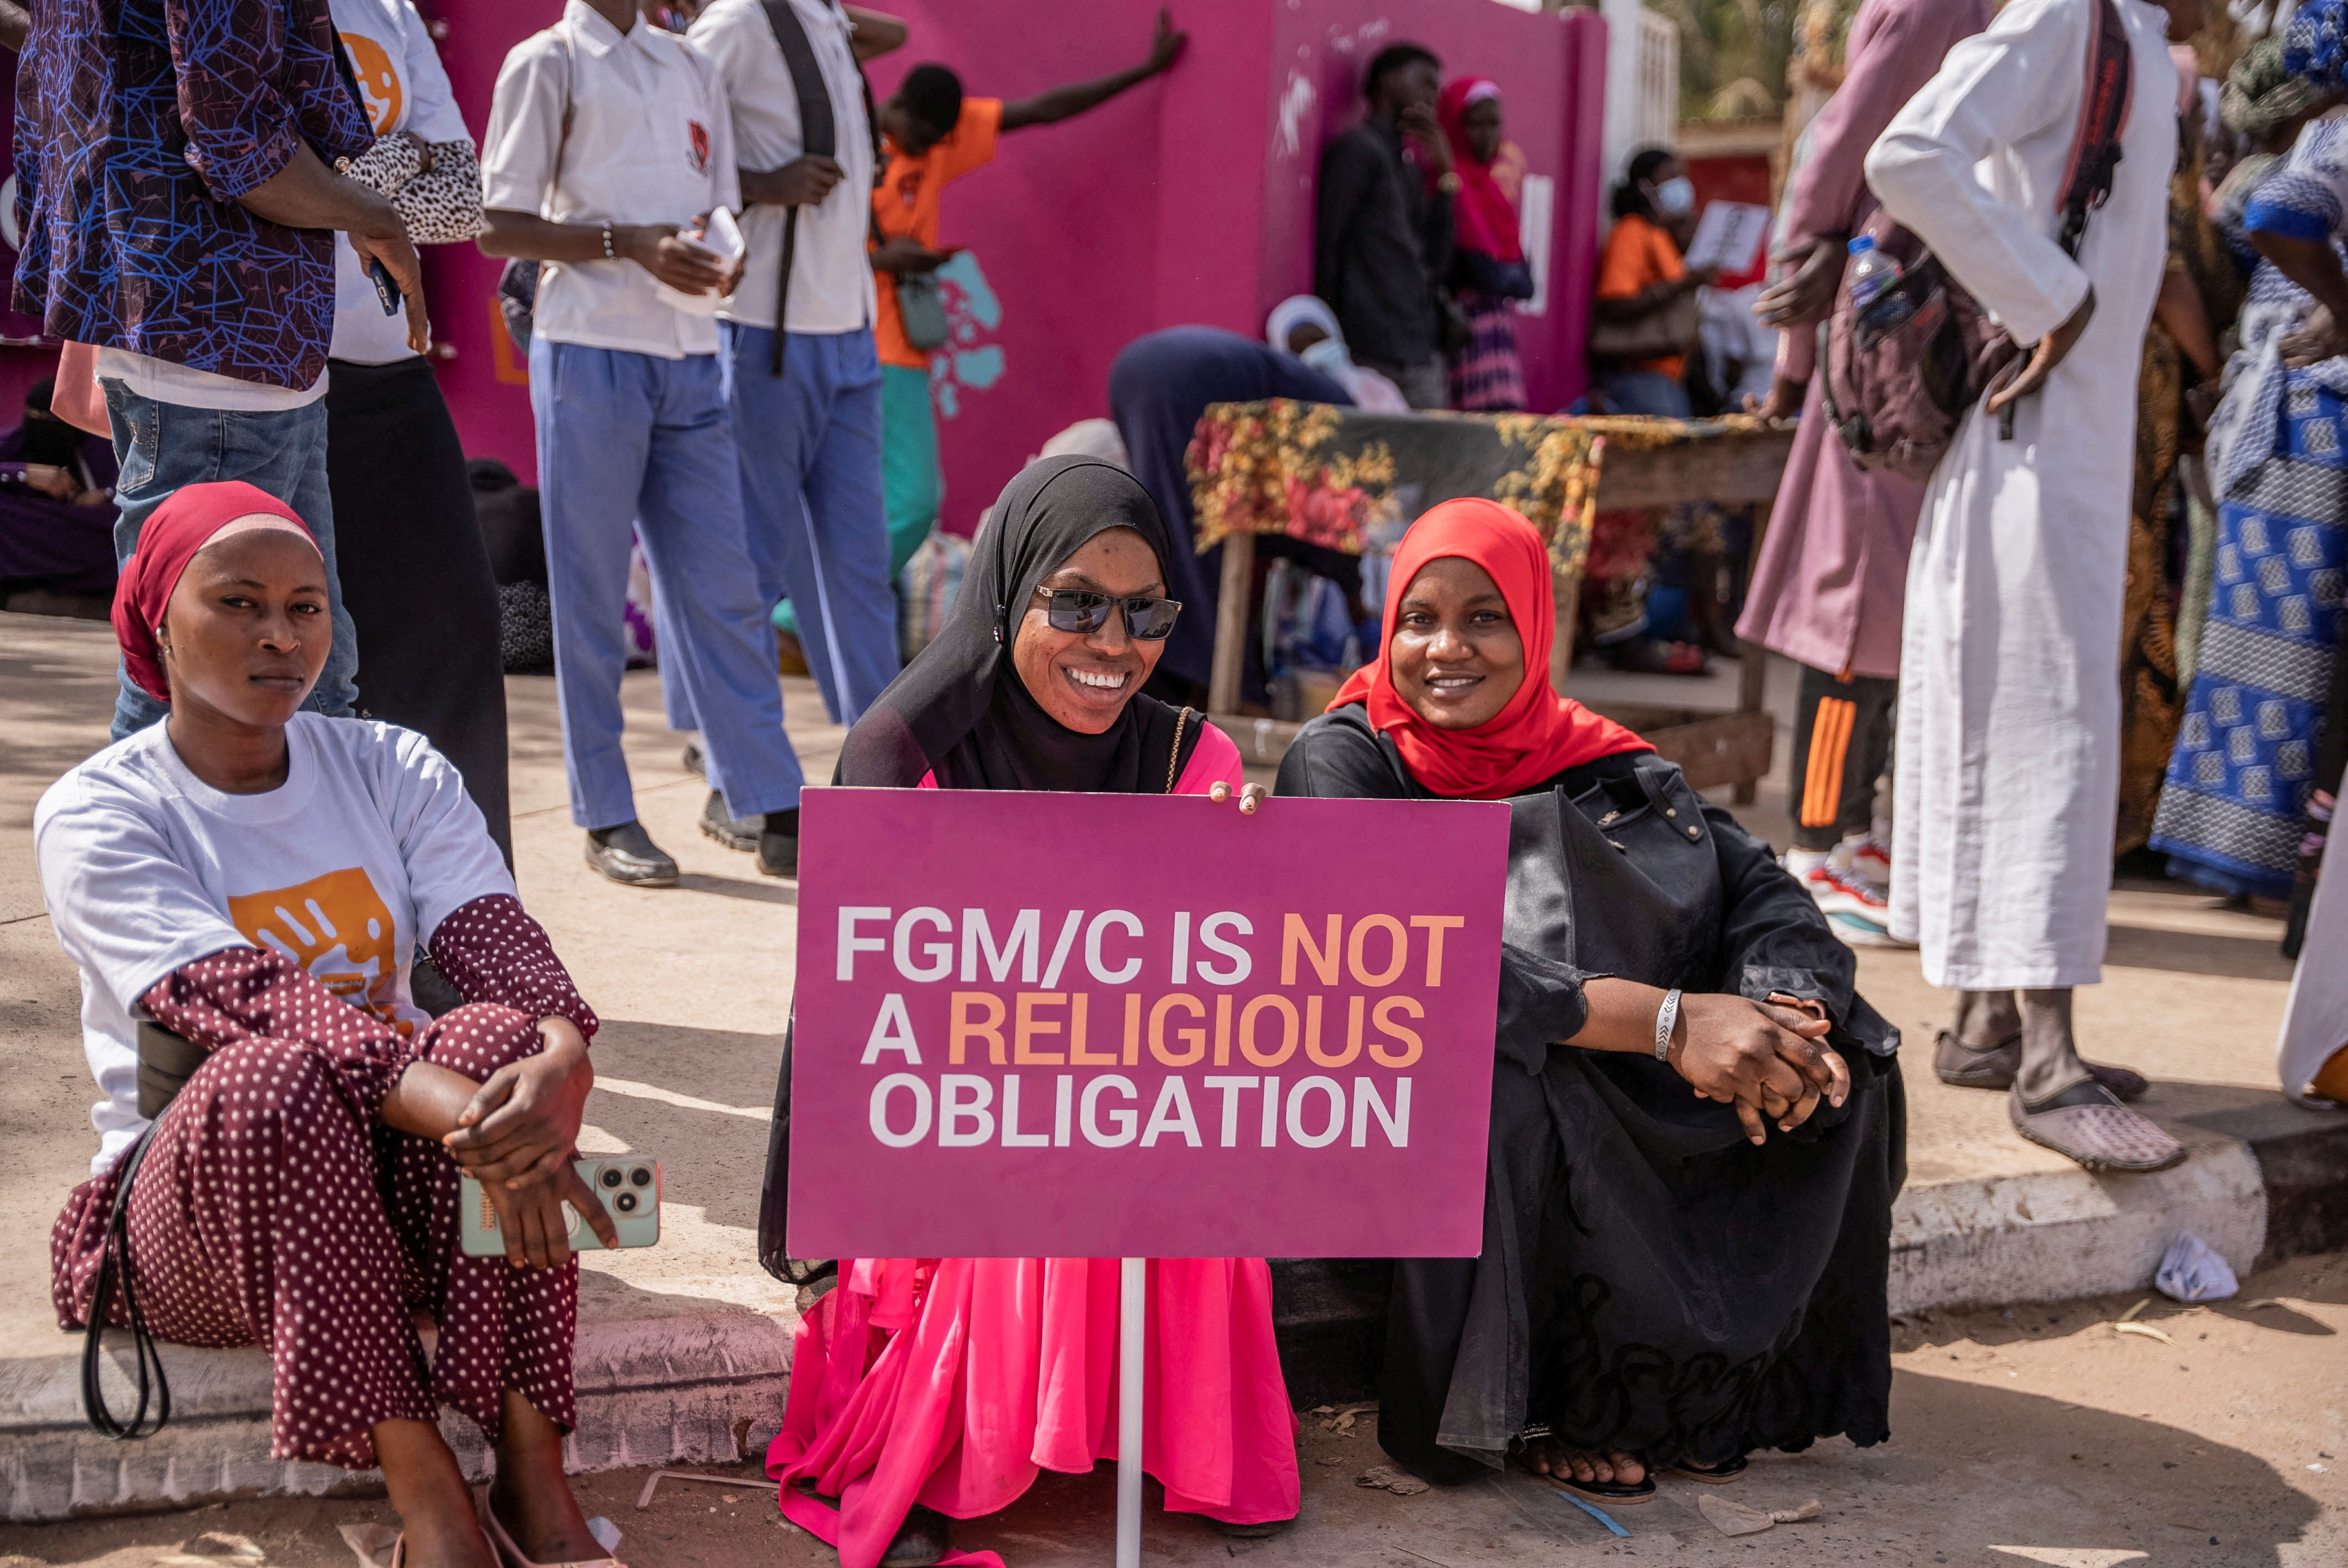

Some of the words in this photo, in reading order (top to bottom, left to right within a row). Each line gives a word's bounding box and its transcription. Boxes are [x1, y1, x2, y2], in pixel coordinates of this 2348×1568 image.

[836, 906, 1144, 989] FGM/C
[1171, 911, 1254, 985] IS
[1280, 913, 1465, 987] NOT
[860, 993, 923, 1065] A
[949, 991, 1425, 1068] RELIGIOUS
[869, 1072, 1412, 1148] OBLIGATION
